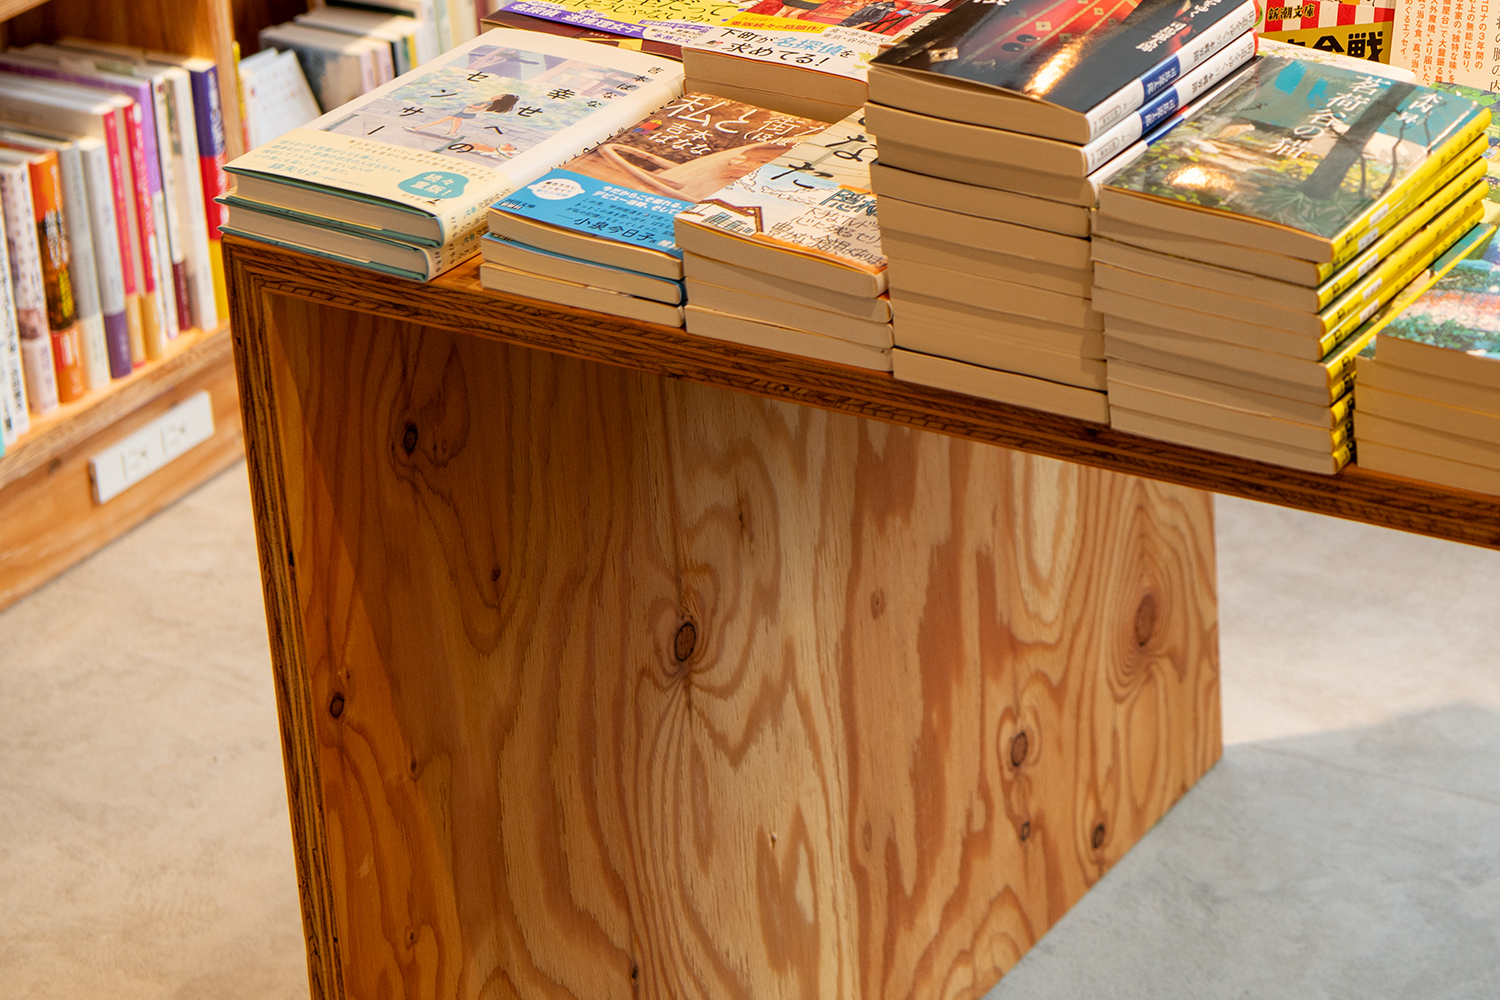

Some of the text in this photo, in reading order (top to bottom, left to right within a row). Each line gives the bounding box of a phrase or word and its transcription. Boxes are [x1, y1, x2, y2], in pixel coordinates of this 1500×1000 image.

[1267, 3, 1316, 21] 新潮文庫
[720, 28, 856, 59] 下町が名探偵を
[722, 41, 831, 67] 求めてる!
[586, 65, 666, 109] 吉本ばなな
[366, 71, 576, 155] 幸せへの センサー
[1265, 73, 1392, 159] 茗荷谷の猫
[649, 131, 711, 155] ばなな
[666, 121, 713, 141] 吉本
[771, 117, 877, 189] なた
[410, 181, 452, 197] 重版!
[422, 172, 455, 187] 続々
[573, 217, 651, 242] 小泉今日子
